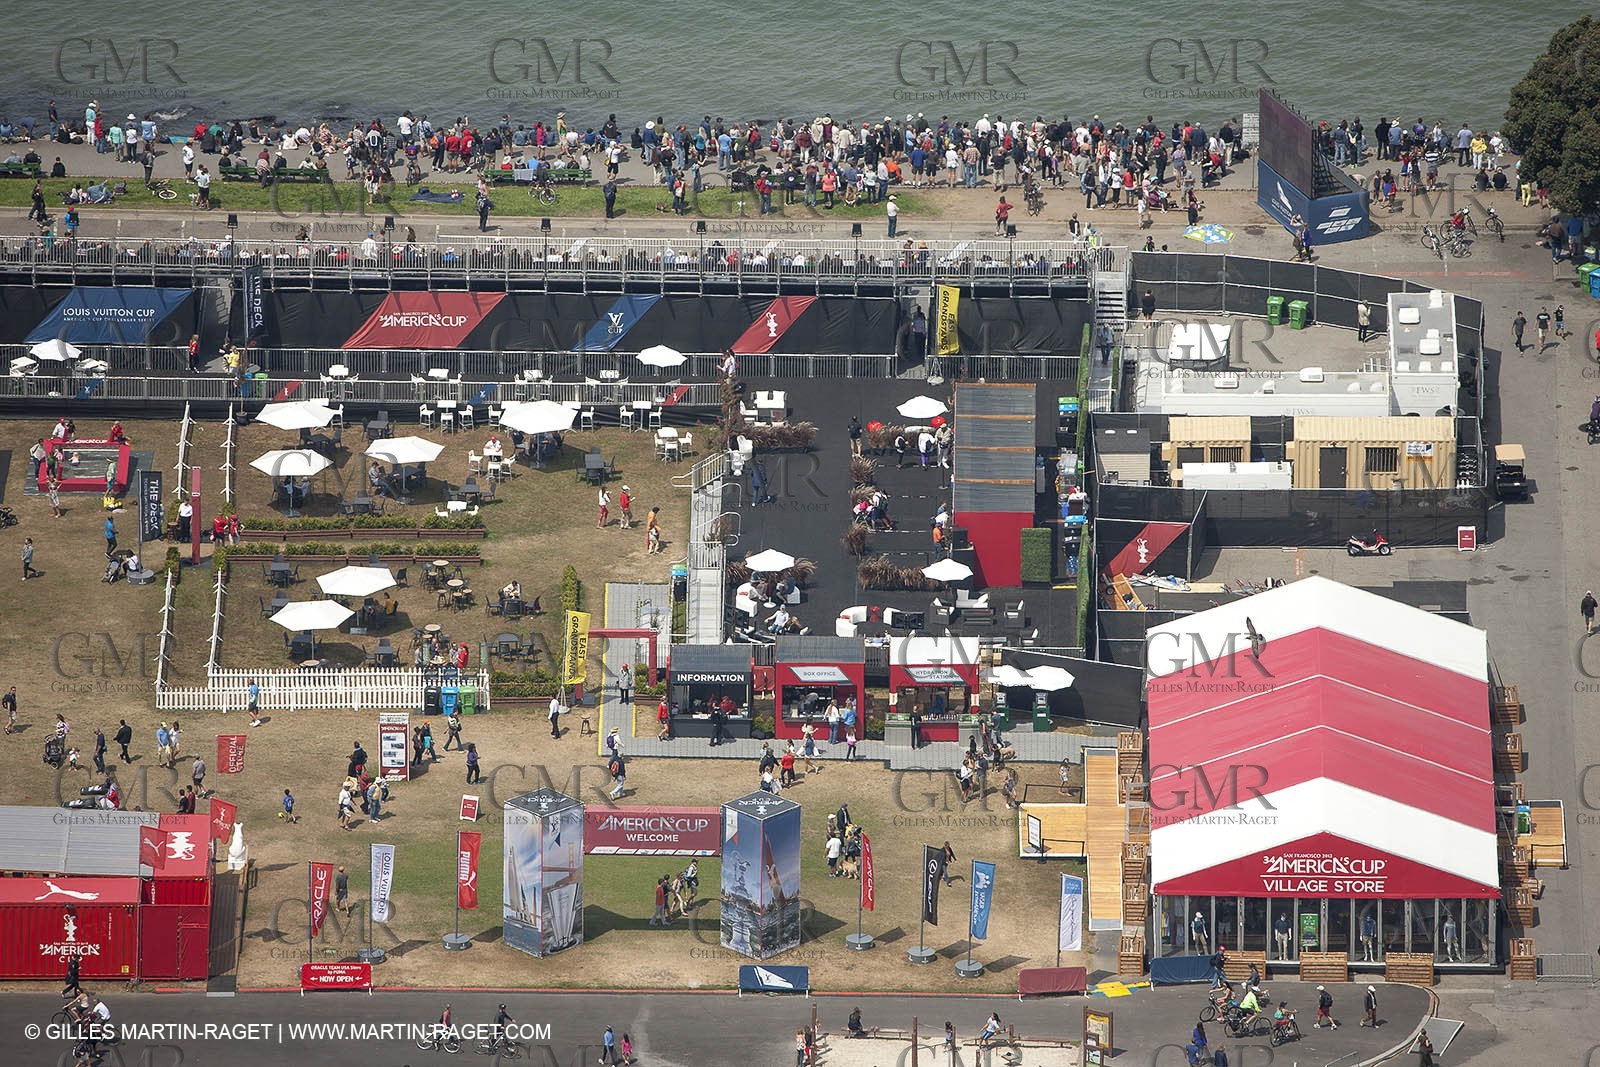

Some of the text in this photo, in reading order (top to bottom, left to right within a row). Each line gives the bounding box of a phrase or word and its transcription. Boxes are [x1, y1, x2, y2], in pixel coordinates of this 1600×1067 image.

[64, 308, 156, 317] LOUIS VUITTON CUP
[254, 298, 264, 328] DECK
[381, 314, 442, 328] AMERICA'S
[442, 316, 468, 327] CUP
[940, 290, 950, 350] GRANDSTANDS
[150, 480, 160, 530] THE DECK
[569, 615, 579, 680] GRANDSTANDS
[578, 637, 586, 661] EAST
[229, 736, 238, 772] OFFICIAL
[236, 744, 244, 772] STORE
[598, 815, 675, 832] AMERICA'S
[675, 818, 709, 832] CUP
[626, 834, 679, 842] WELCOME
[459, 850, 471, 881] PUMA
[1263, 856, 1386, 875] 34 AMERICA'S CUP
[378, 852, 391, 914] LOUIS VUITTON
[1263, 880, 1385, 893] VILLAGE STORE
[42, 944, 100, 956] AMERICA'S
